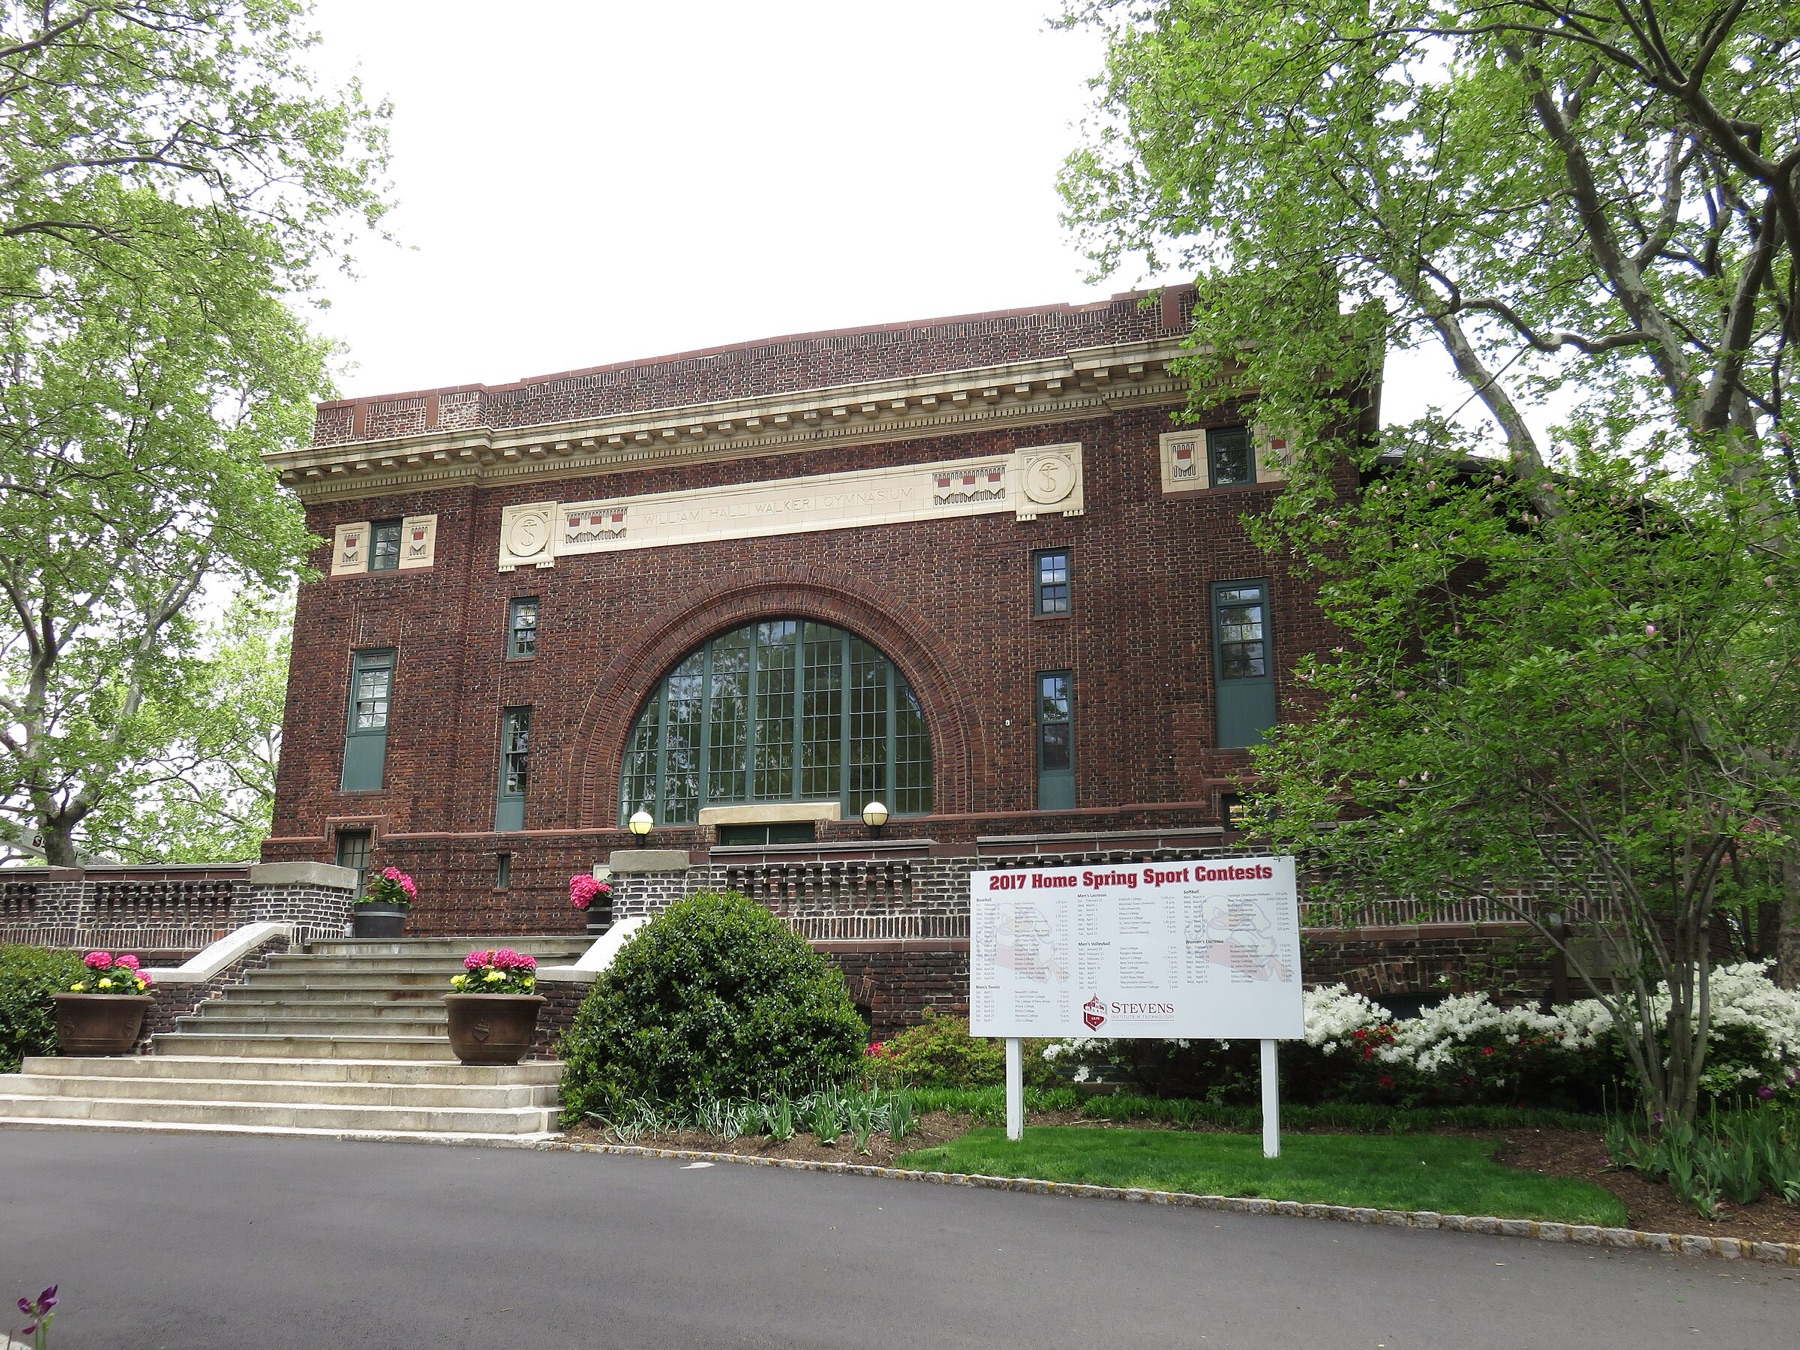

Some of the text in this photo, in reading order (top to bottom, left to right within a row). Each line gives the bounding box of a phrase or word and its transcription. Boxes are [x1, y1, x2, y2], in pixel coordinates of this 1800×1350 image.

[644, 488, 913, 525] WILLIAM HALL WALKER GYMNASIUM
[990, 864, 1272, 890] 2017 Home Spring Sport Contests
[1111, 1002, 1174, 1014] STEVENS
